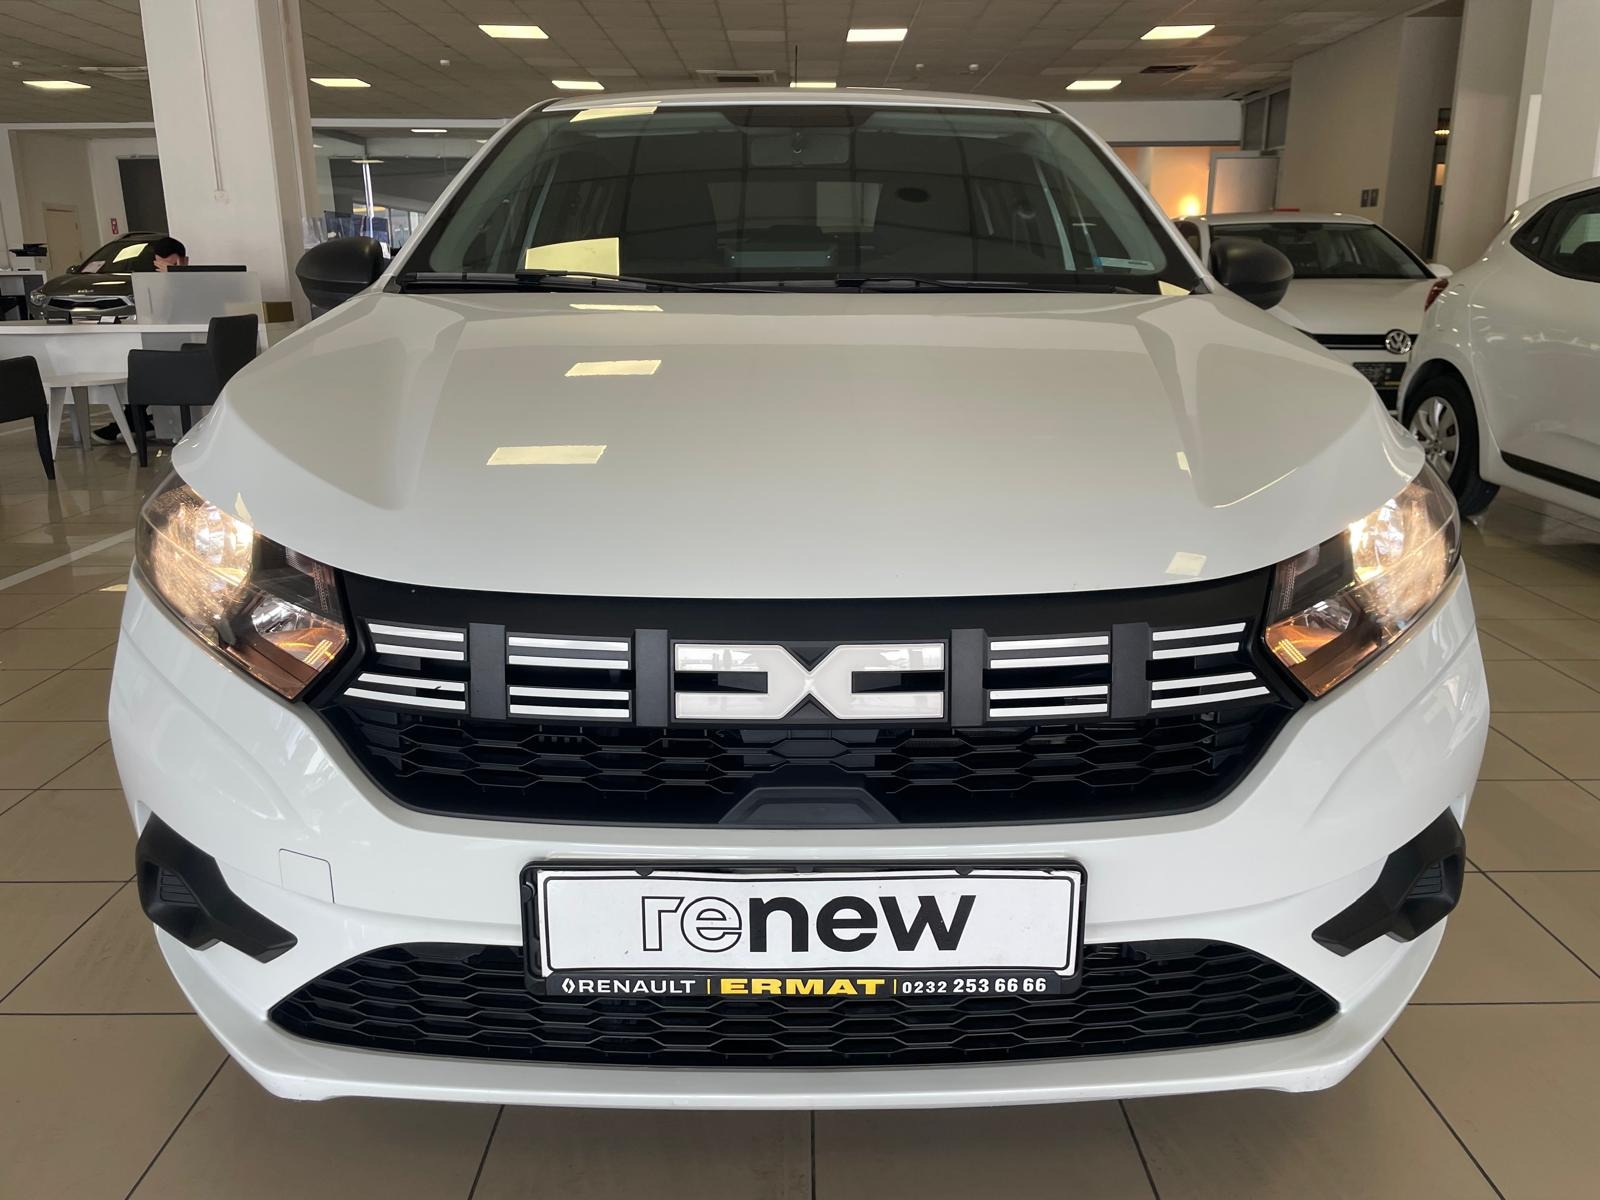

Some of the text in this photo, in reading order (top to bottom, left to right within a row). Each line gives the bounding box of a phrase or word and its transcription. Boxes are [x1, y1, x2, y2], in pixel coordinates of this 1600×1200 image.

[642, 895, 976, 953] renew
[578, 977, 1047, 995] RENAULT ERMAT 0232 253 66 66
